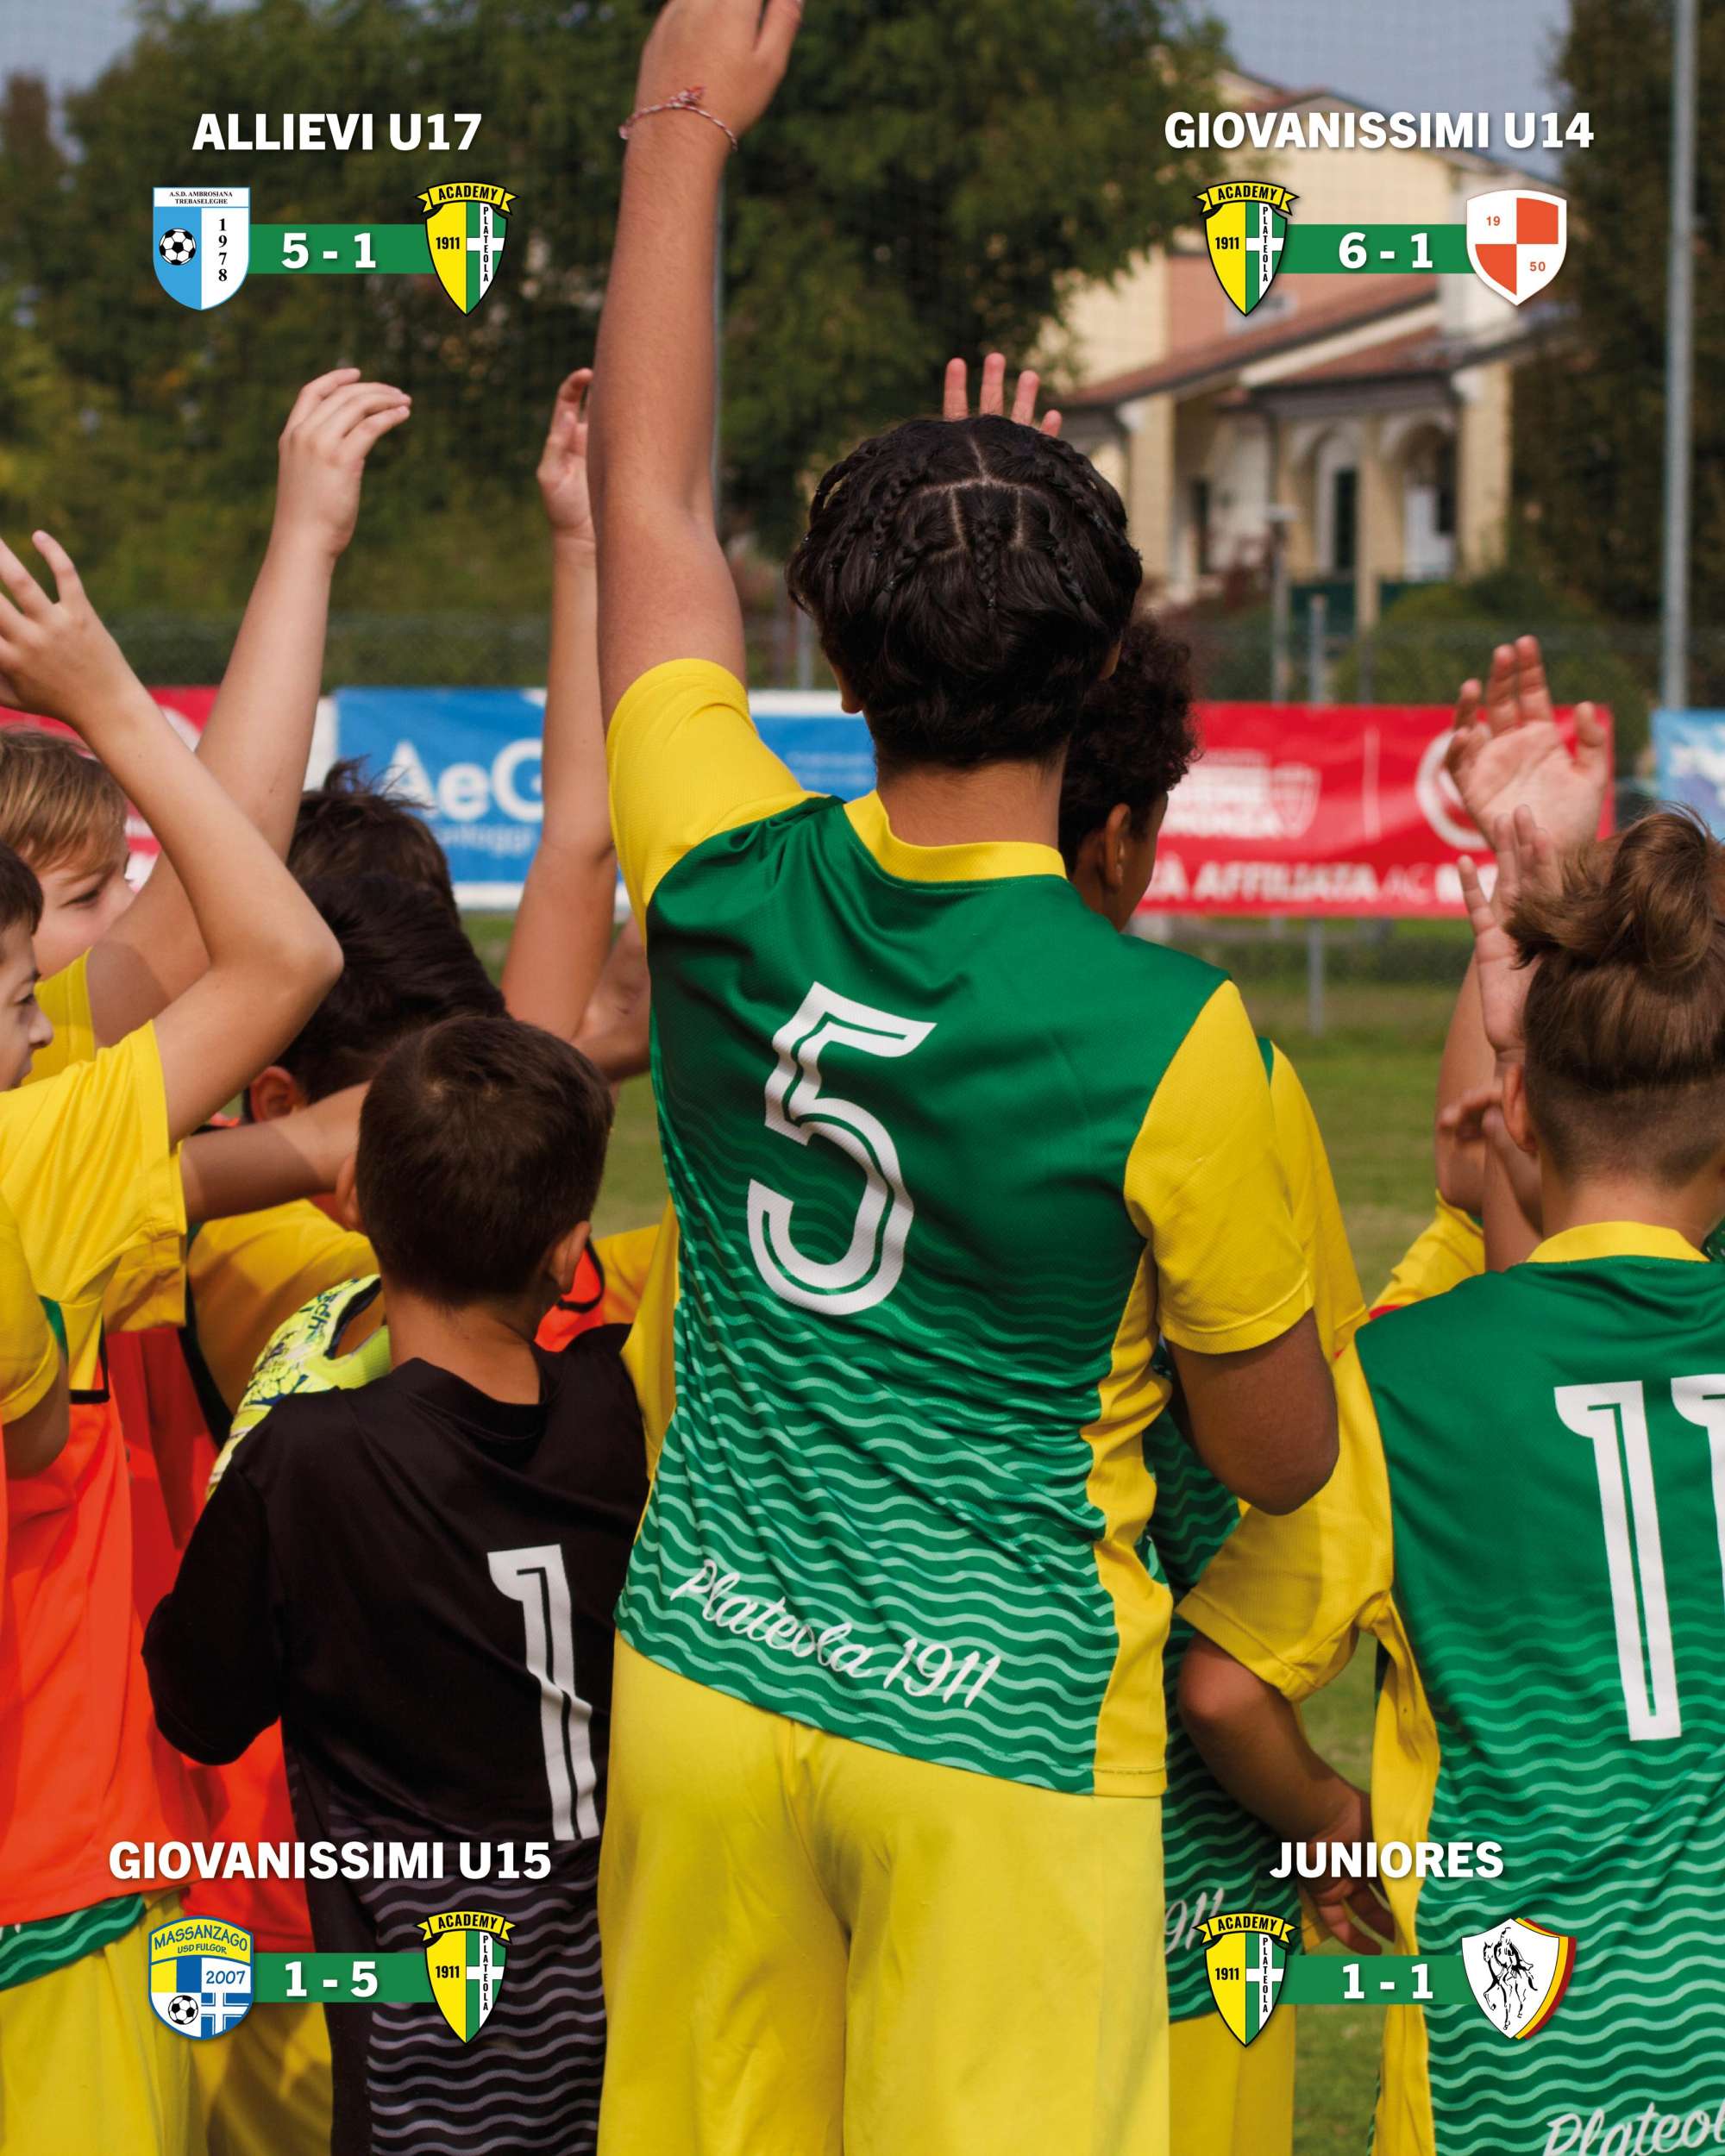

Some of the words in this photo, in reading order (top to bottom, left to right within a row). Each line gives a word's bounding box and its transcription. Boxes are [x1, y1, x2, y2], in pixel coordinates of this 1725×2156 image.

[747, 981, 938, 1315] 5
[487, 1544, 601, 1841] 1
[669, 1559, 874, 1678] Plateola
[883, 1638, 1000, 1708] 1911
